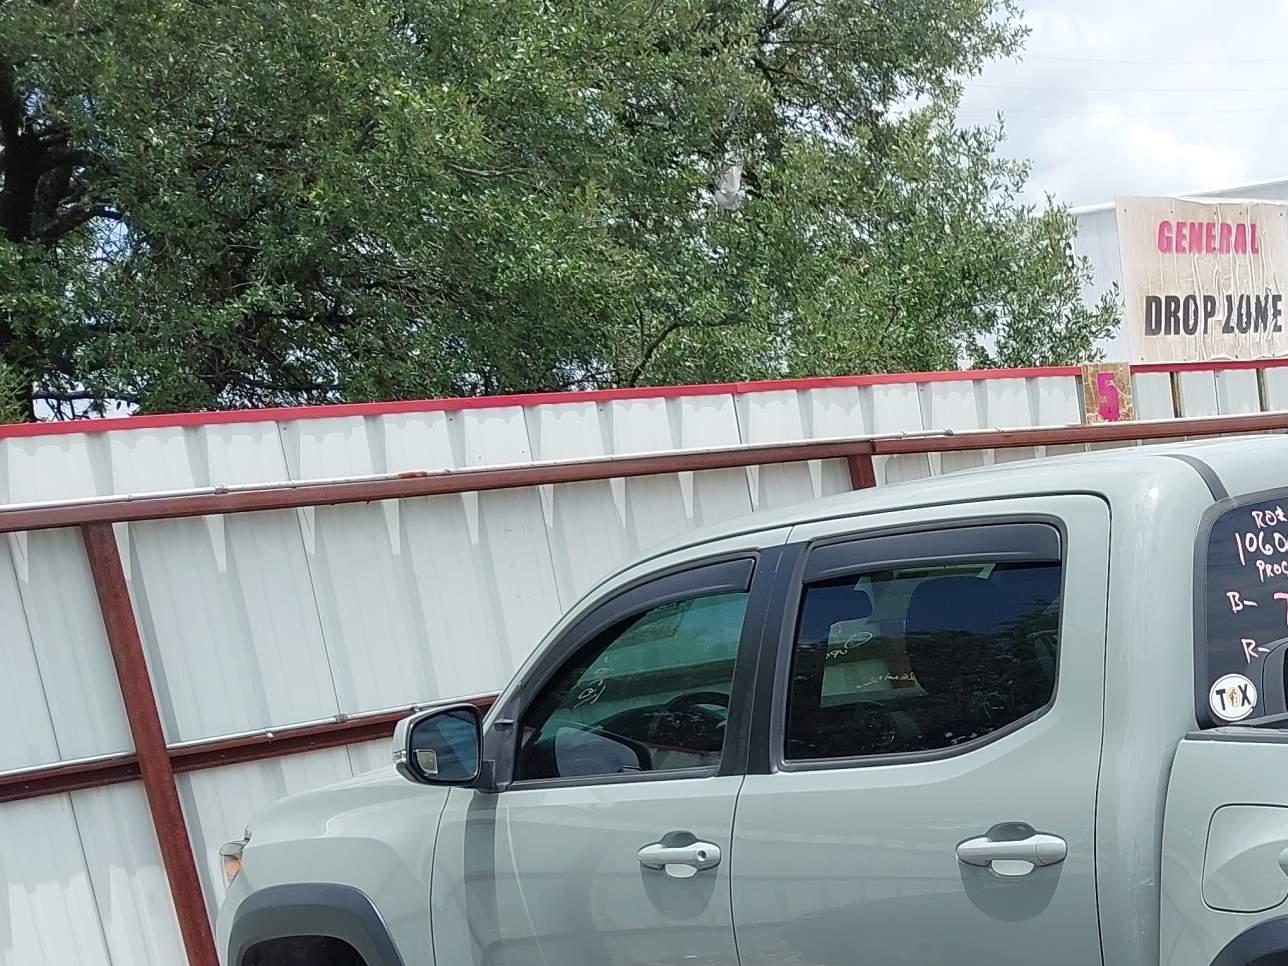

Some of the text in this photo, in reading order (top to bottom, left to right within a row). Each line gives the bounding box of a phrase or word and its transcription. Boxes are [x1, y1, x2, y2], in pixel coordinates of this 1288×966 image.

[1157, 220, 1259, 256] GENERAL
[1145, 291, 1283, 336] DROP ZONE
[1097, 372, 1120, 421] 5
